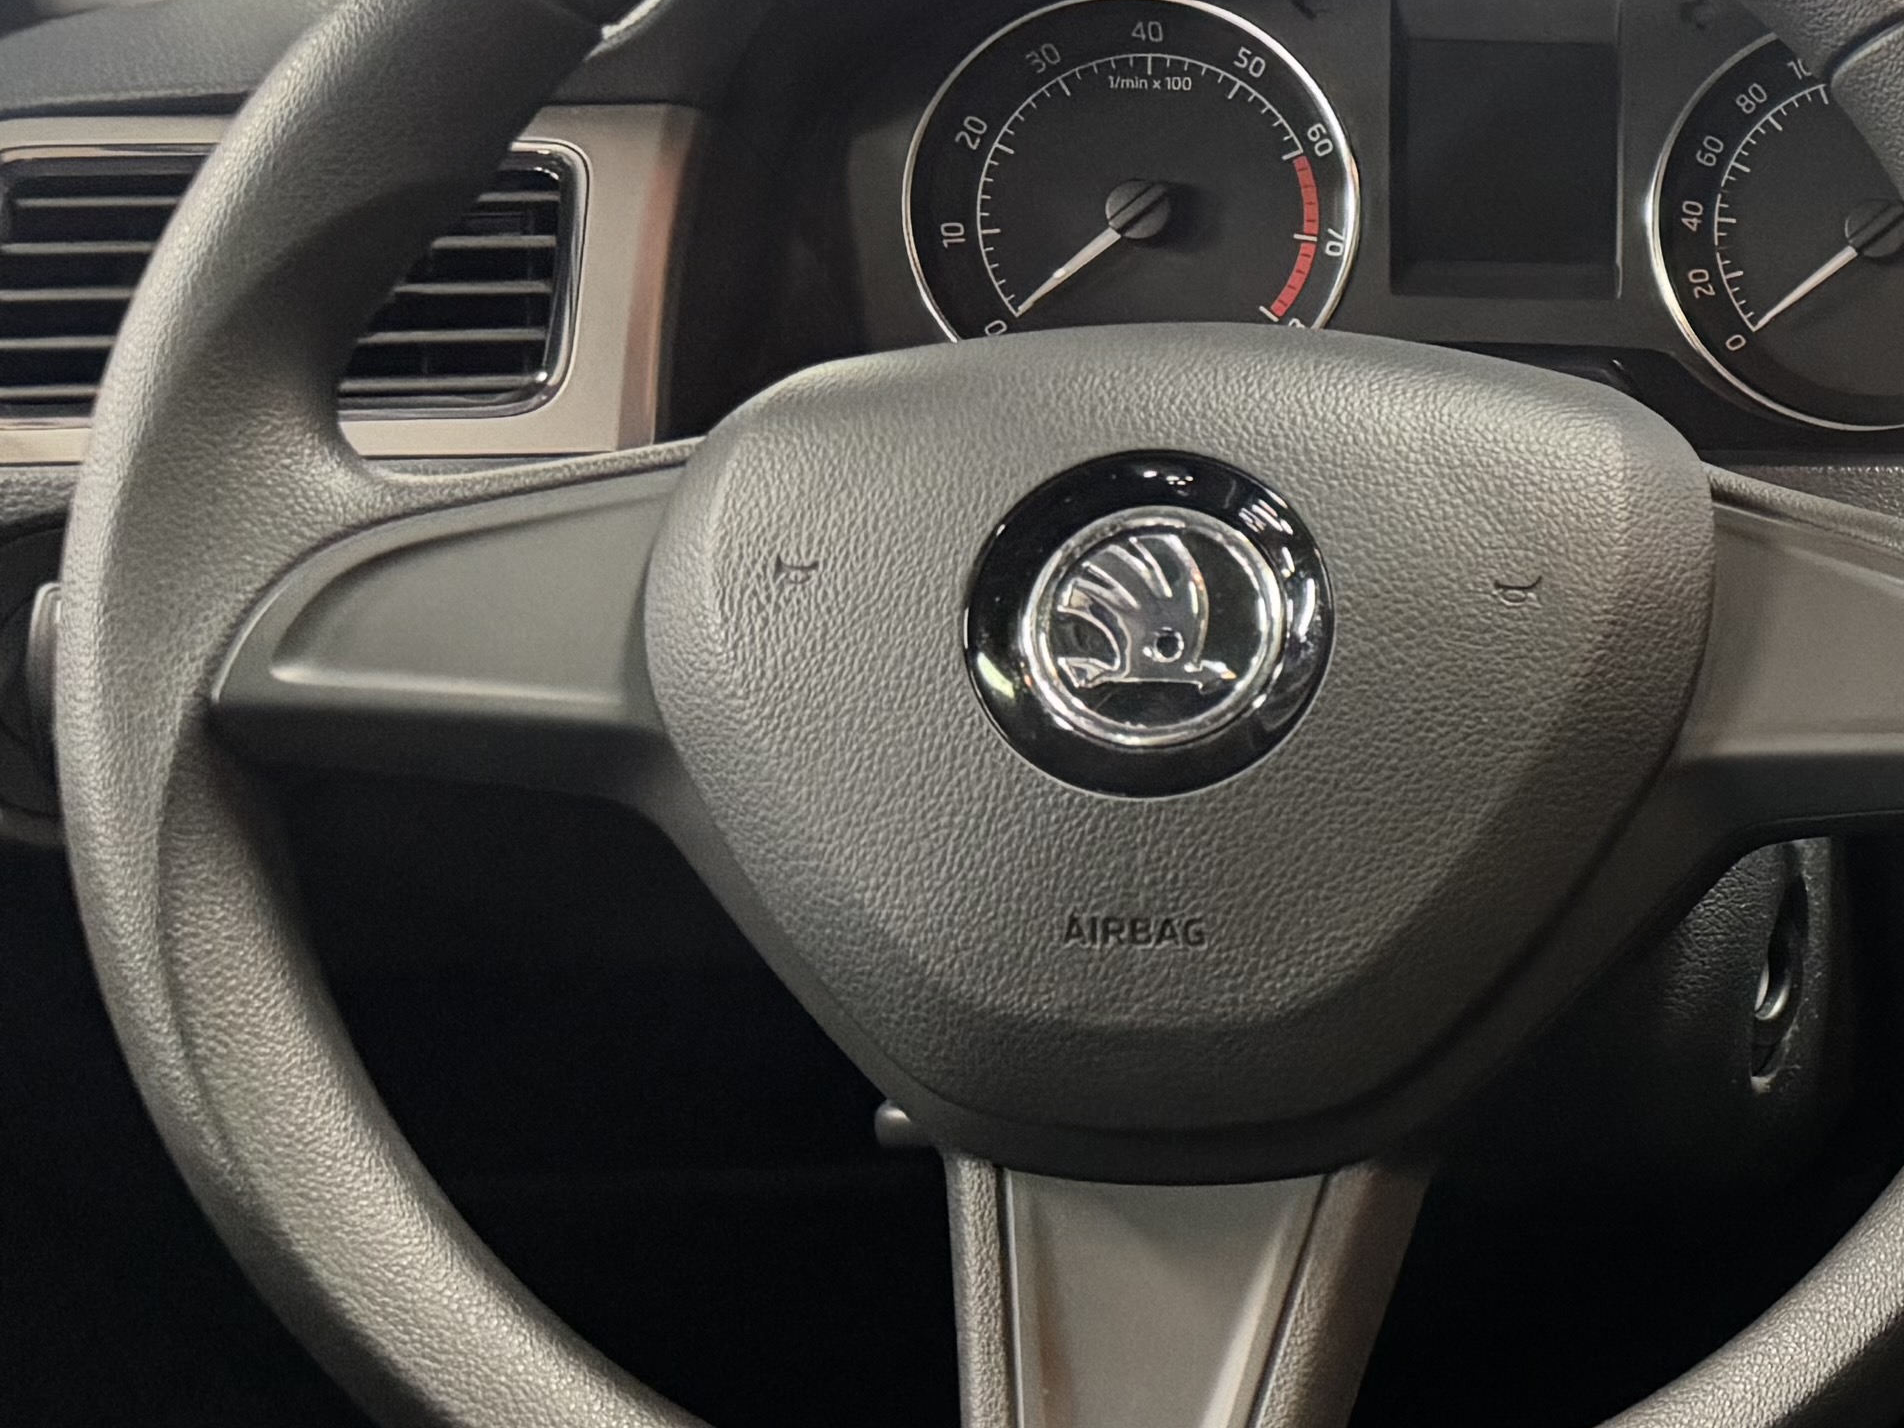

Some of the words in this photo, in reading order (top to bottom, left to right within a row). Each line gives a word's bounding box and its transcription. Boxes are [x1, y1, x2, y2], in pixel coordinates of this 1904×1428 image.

[1131, 20, 1164, 44] 40
[1025, 42, 1062, 74] 30
[1233, 46, 1268, 79] 50
[1107, 75, 1148, 91] 1/min
[1163, 75, 1193, 91] 100
[1735, 83, 1768, 114] 80
[955, 115, 988, 151] 20
[1306, 122, 1334, 157] 60
[1696, 136, 1725, 168] 60
[1680, 200, 1704, 232] 40
[940, 221, 967, 248] 10
[1324, 227, 1347, 259] 70
[1687, 268, 1717, 299] 20
[1725, 334, 1747, 352] 0
[1064, 913, 1206, 947] AIRBAG
